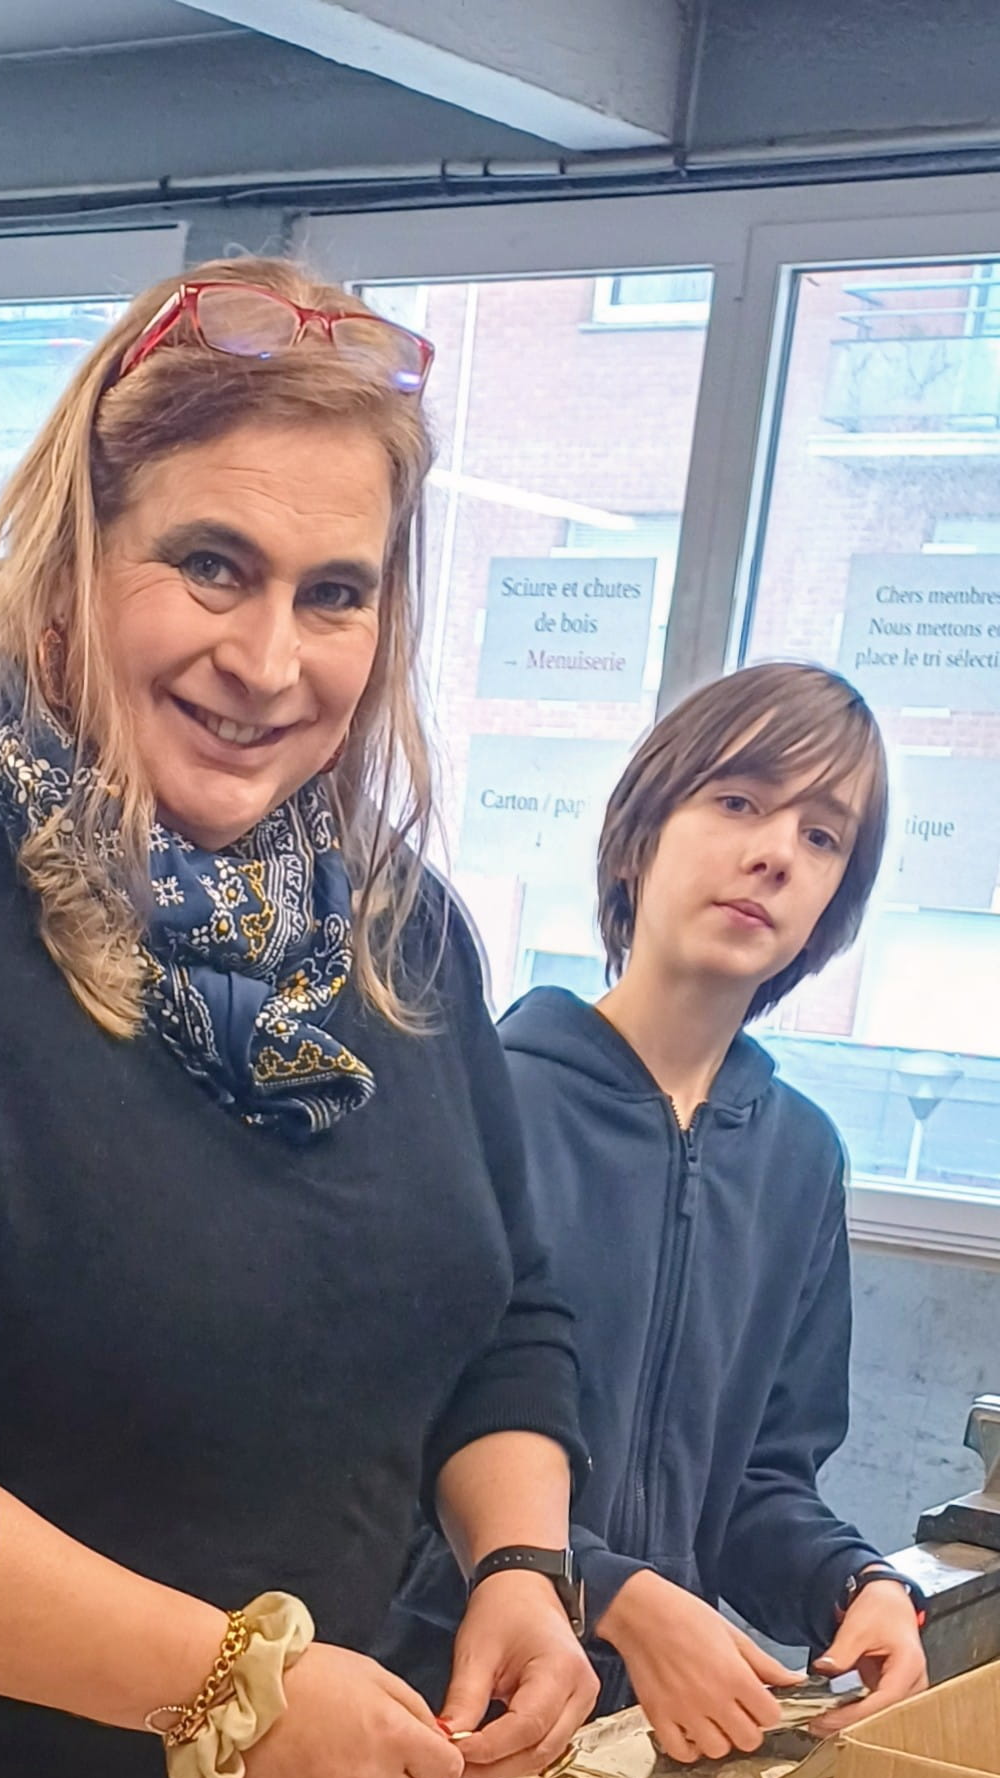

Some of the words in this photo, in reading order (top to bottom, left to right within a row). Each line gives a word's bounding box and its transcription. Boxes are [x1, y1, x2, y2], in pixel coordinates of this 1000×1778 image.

[501, 576, 558, 598] Sciure
[562, 580, 578, 598] et
[583, 576, 642, 599] chutes
[876, 585, 924, 604] Chers
[534, 611, 557, 633] de
[560, 611, 599, 634] bois
[868, 617, 912, 636] Nous
[916, 622, 982, 638] mettons
[525, 649, 627, 671] Menuiserie
[855, 647, 899, 670] place
[903, 647, 919, 667] le
[922, 649, 942, 667] tri
[480, 788, 539, 812] Carton
